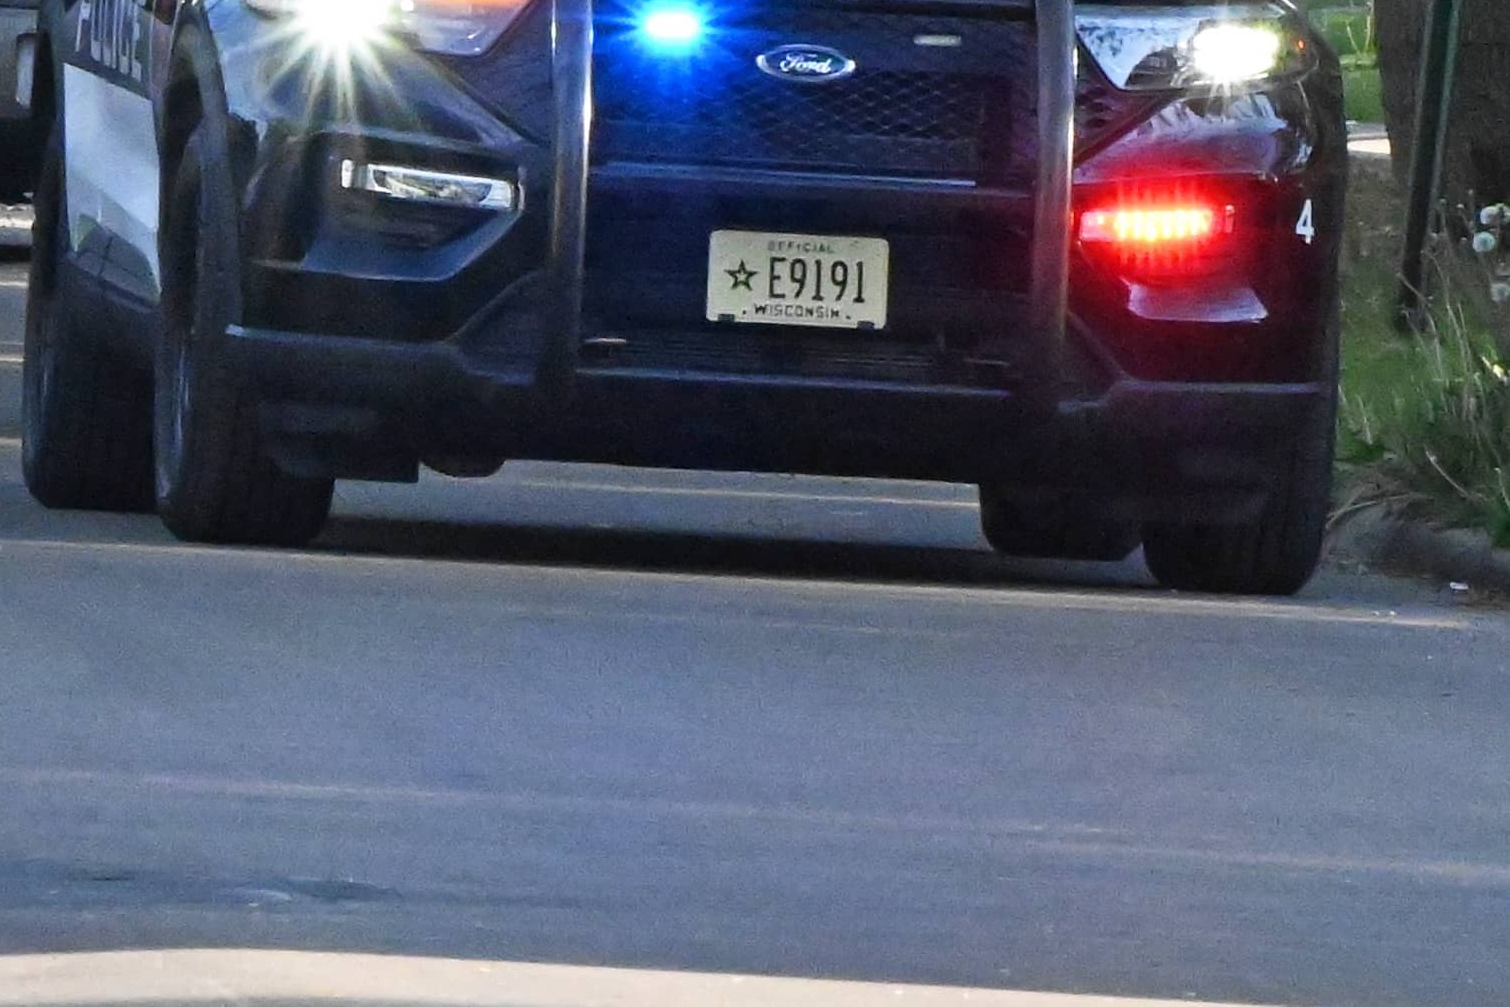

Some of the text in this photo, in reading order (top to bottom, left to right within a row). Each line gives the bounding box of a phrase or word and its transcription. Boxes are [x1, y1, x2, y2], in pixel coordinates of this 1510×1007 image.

[779, 53, 833, 75] Ford
[1295, 198, 1315, 245] 4
[767, 240, 835, 254] OFFICIAL
[768, 256, 866, 304] E9191
[753, 303, 840, 319] WISCONSIN
